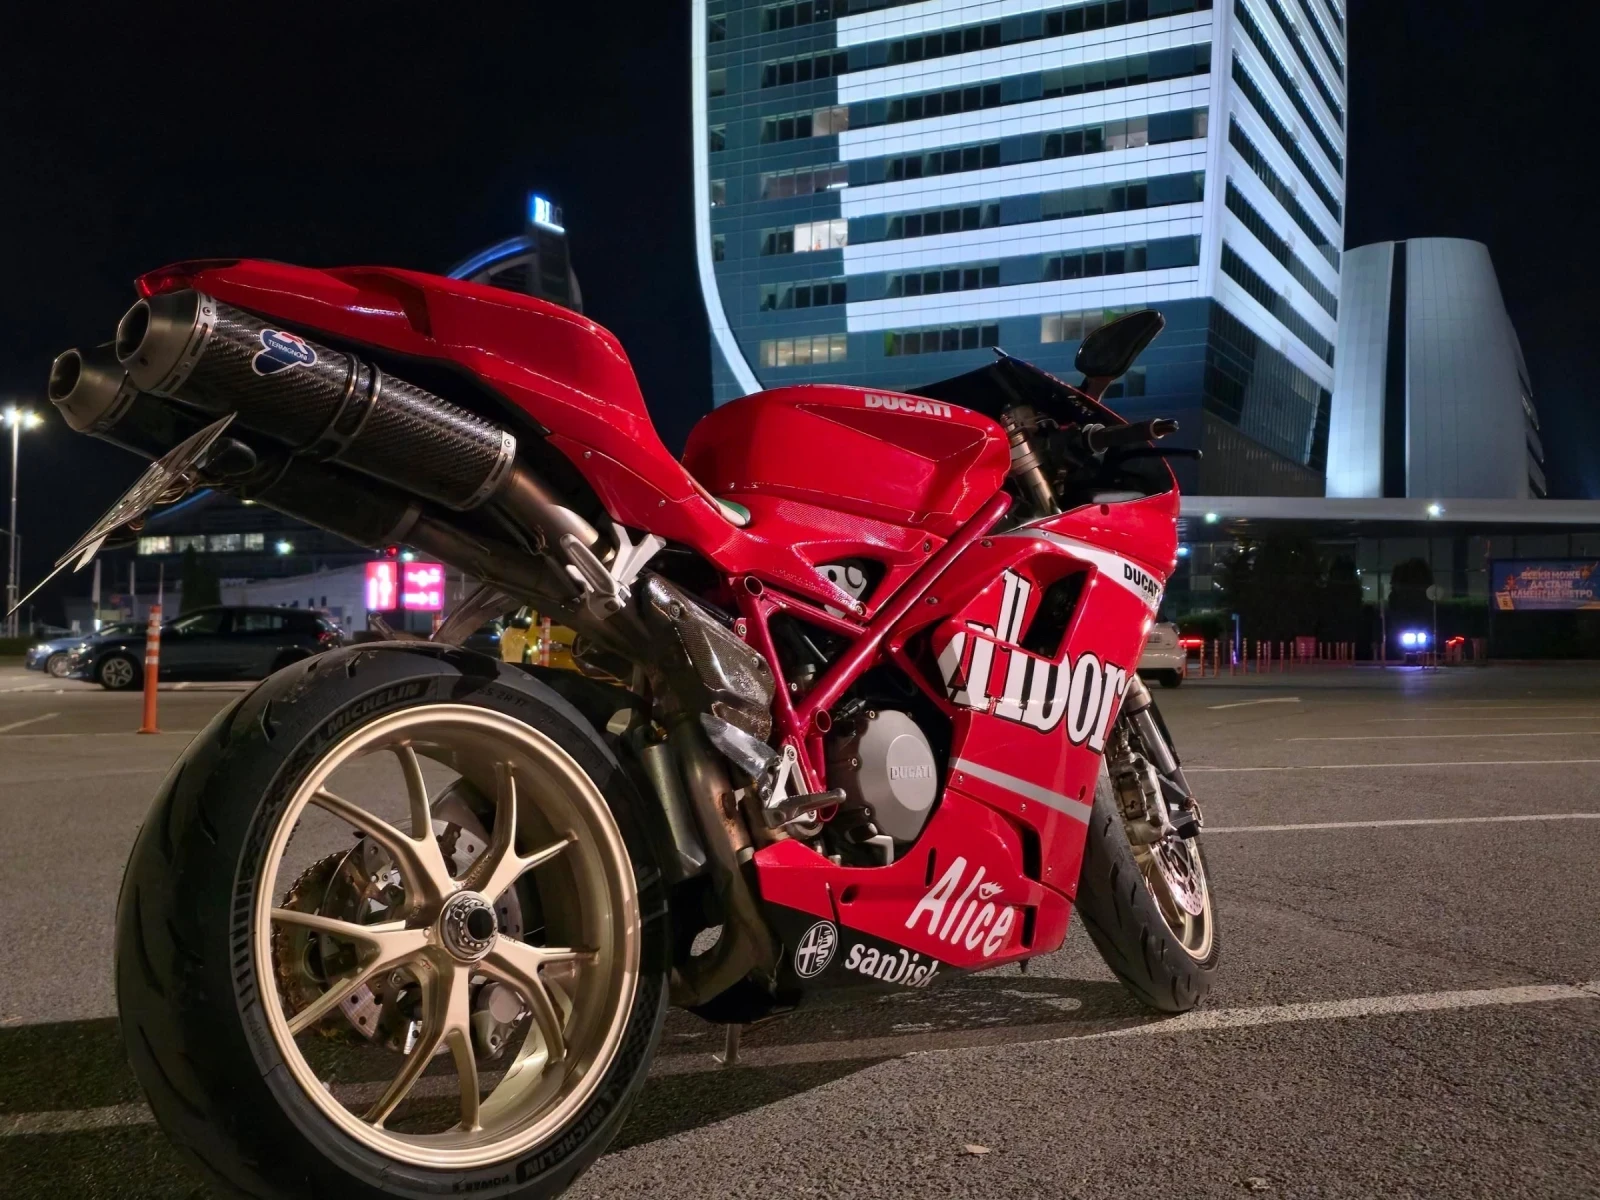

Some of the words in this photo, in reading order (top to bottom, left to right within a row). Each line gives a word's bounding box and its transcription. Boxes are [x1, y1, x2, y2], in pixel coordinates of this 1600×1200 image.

[268, 339, 308, 361] TERMIGNONI
[864, 393, 952, 419] DUCATI
[327, 683, 421, 737] MICHELIN
[890, 764, 933, 780] DUCATI
[904, 856, 1015, 958] Alice
[523, 1103, 606, 1178] MICHELIN
